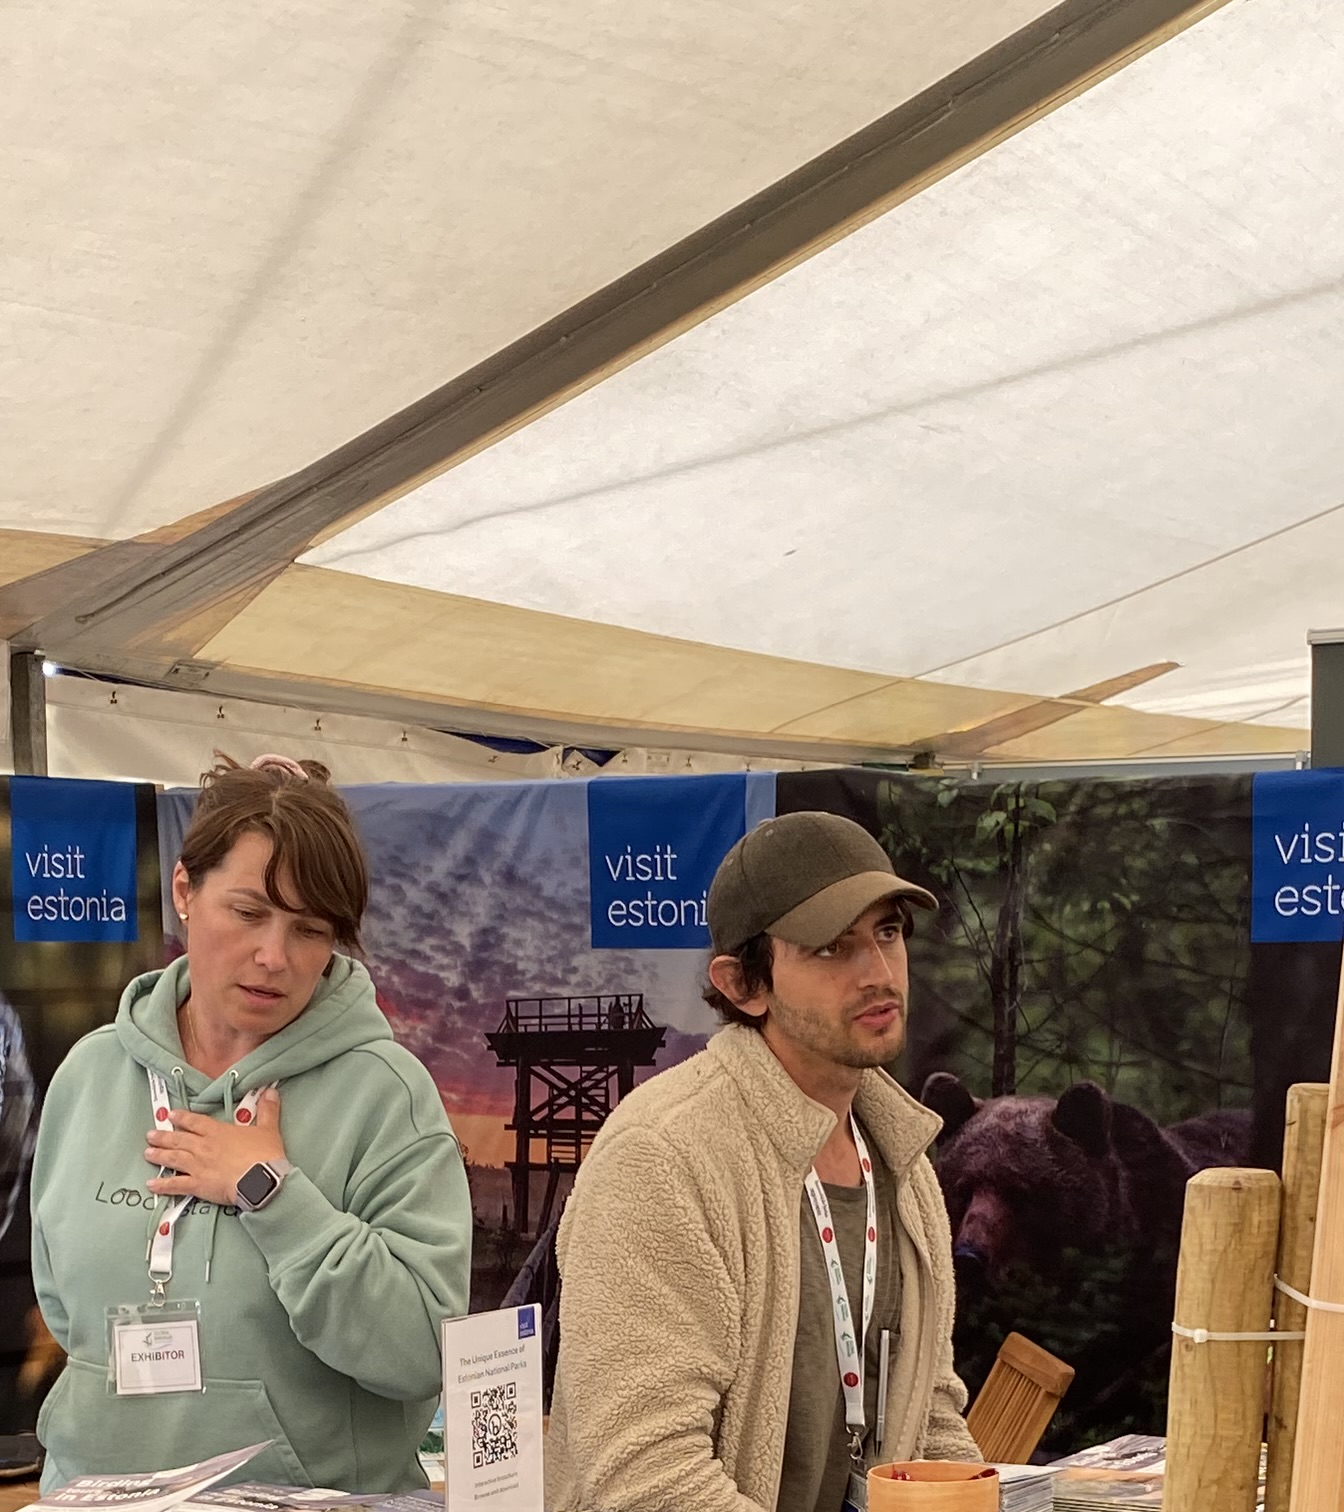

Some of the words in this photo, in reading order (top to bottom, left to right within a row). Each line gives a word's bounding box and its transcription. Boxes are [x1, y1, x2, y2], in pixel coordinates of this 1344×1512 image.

[25, 844, 86, 879] visit
[605, 844, 677, 881] visit
[27, 887, 126, 922] estonia
[607, 889, 708, 926] estoni
[131, 1350, 185, 1362] EXHIBITOR
[458, 1370, 485, 1384] Estonian
[485, 1363, 510, 1377] National
[510, 1360, 527, 1371] Parks
[459, 1357, 471, 1367] The
[472, 1353, 493, 1365] Unique
[494, 1348, 519, 1359] Essence
